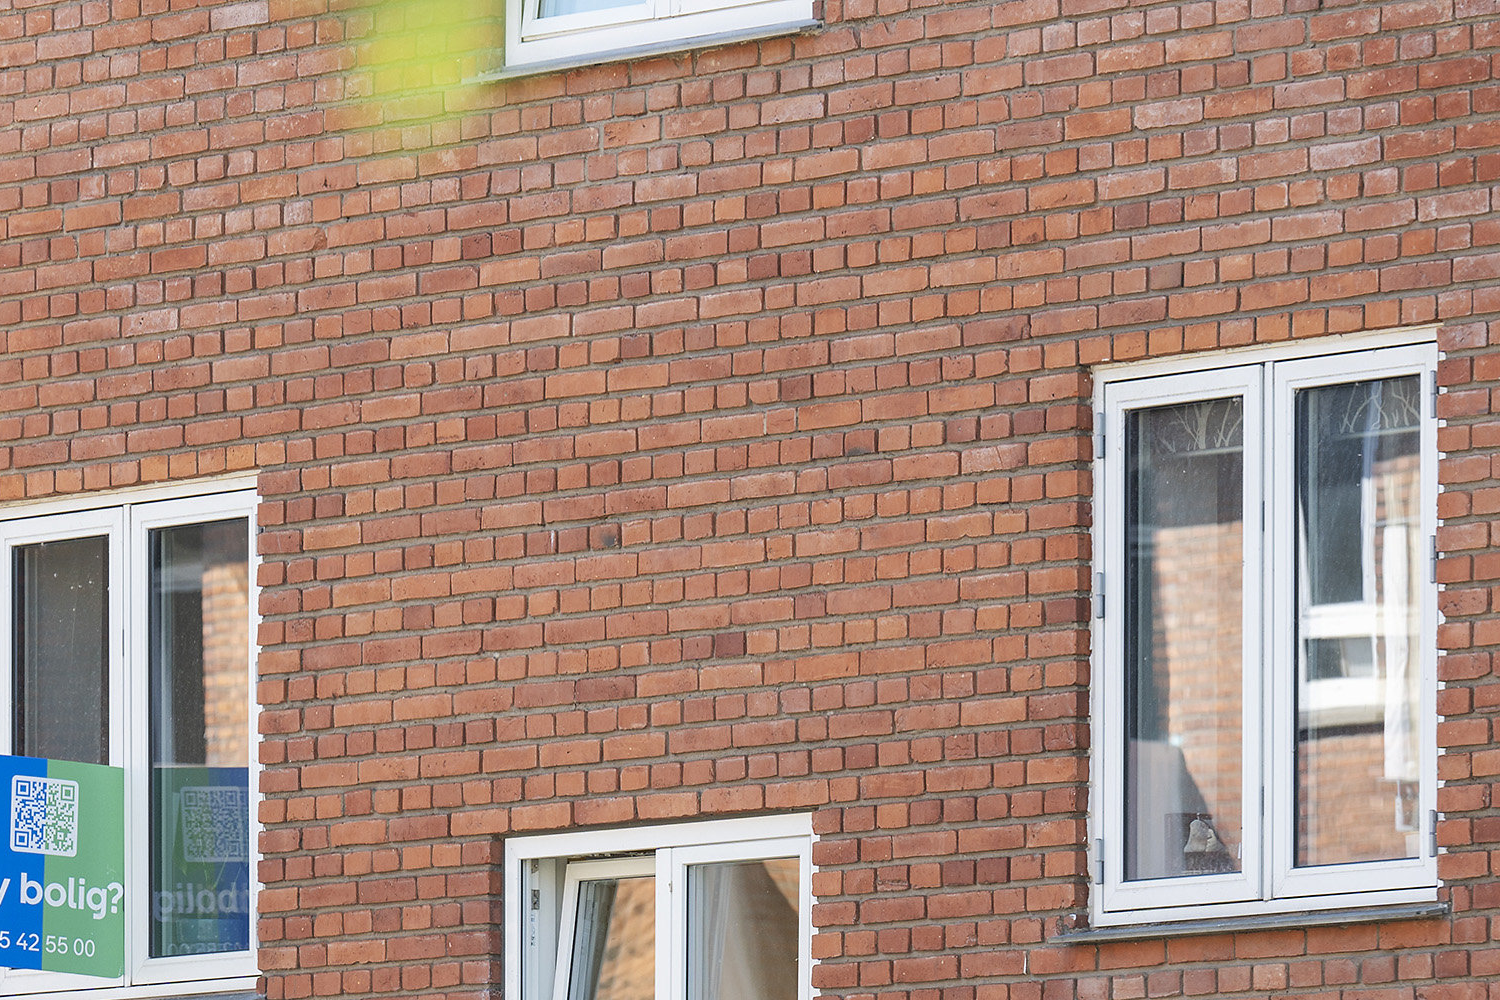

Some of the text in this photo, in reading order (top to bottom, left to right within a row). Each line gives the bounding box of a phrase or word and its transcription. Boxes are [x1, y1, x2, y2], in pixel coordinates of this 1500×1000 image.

[19, 872, 124, 920] bolig?
[16, 932, 40, 952] 42
[45, 935, 68, 954] 55
[73, 938, 95, 958] 00
